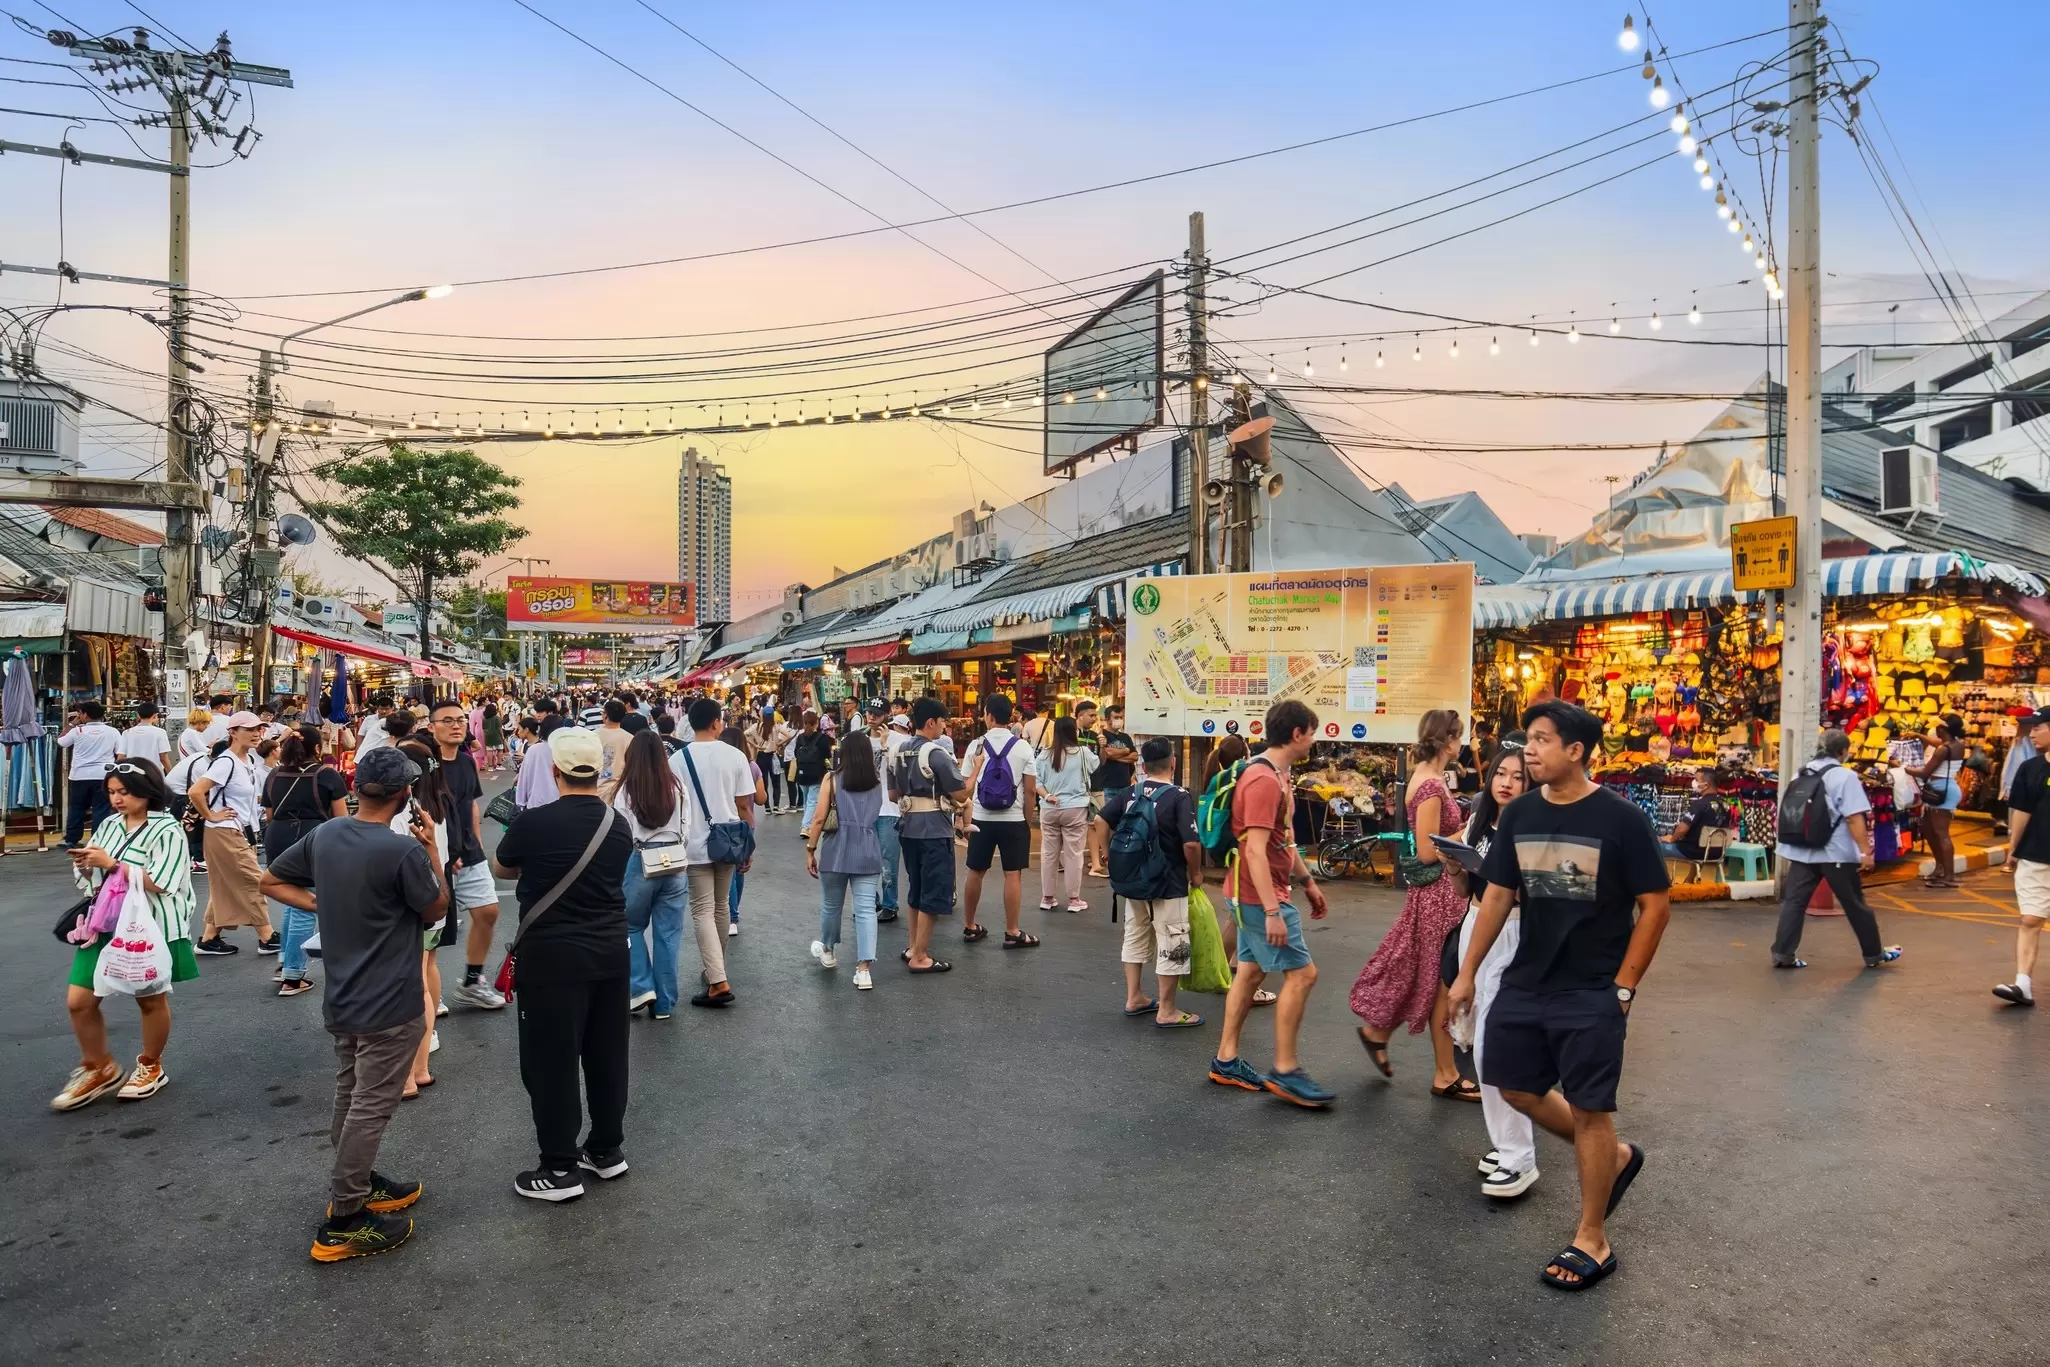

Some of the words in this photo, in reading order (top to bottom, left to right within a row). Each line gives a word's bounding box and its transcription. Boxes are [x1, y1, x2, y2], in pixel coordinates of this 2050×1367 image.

[525, 586, 571, 603] กรอบ
[1248, 595, 1288, 605] Chatuchak
[529, 597, 575, 614] อร่อย
